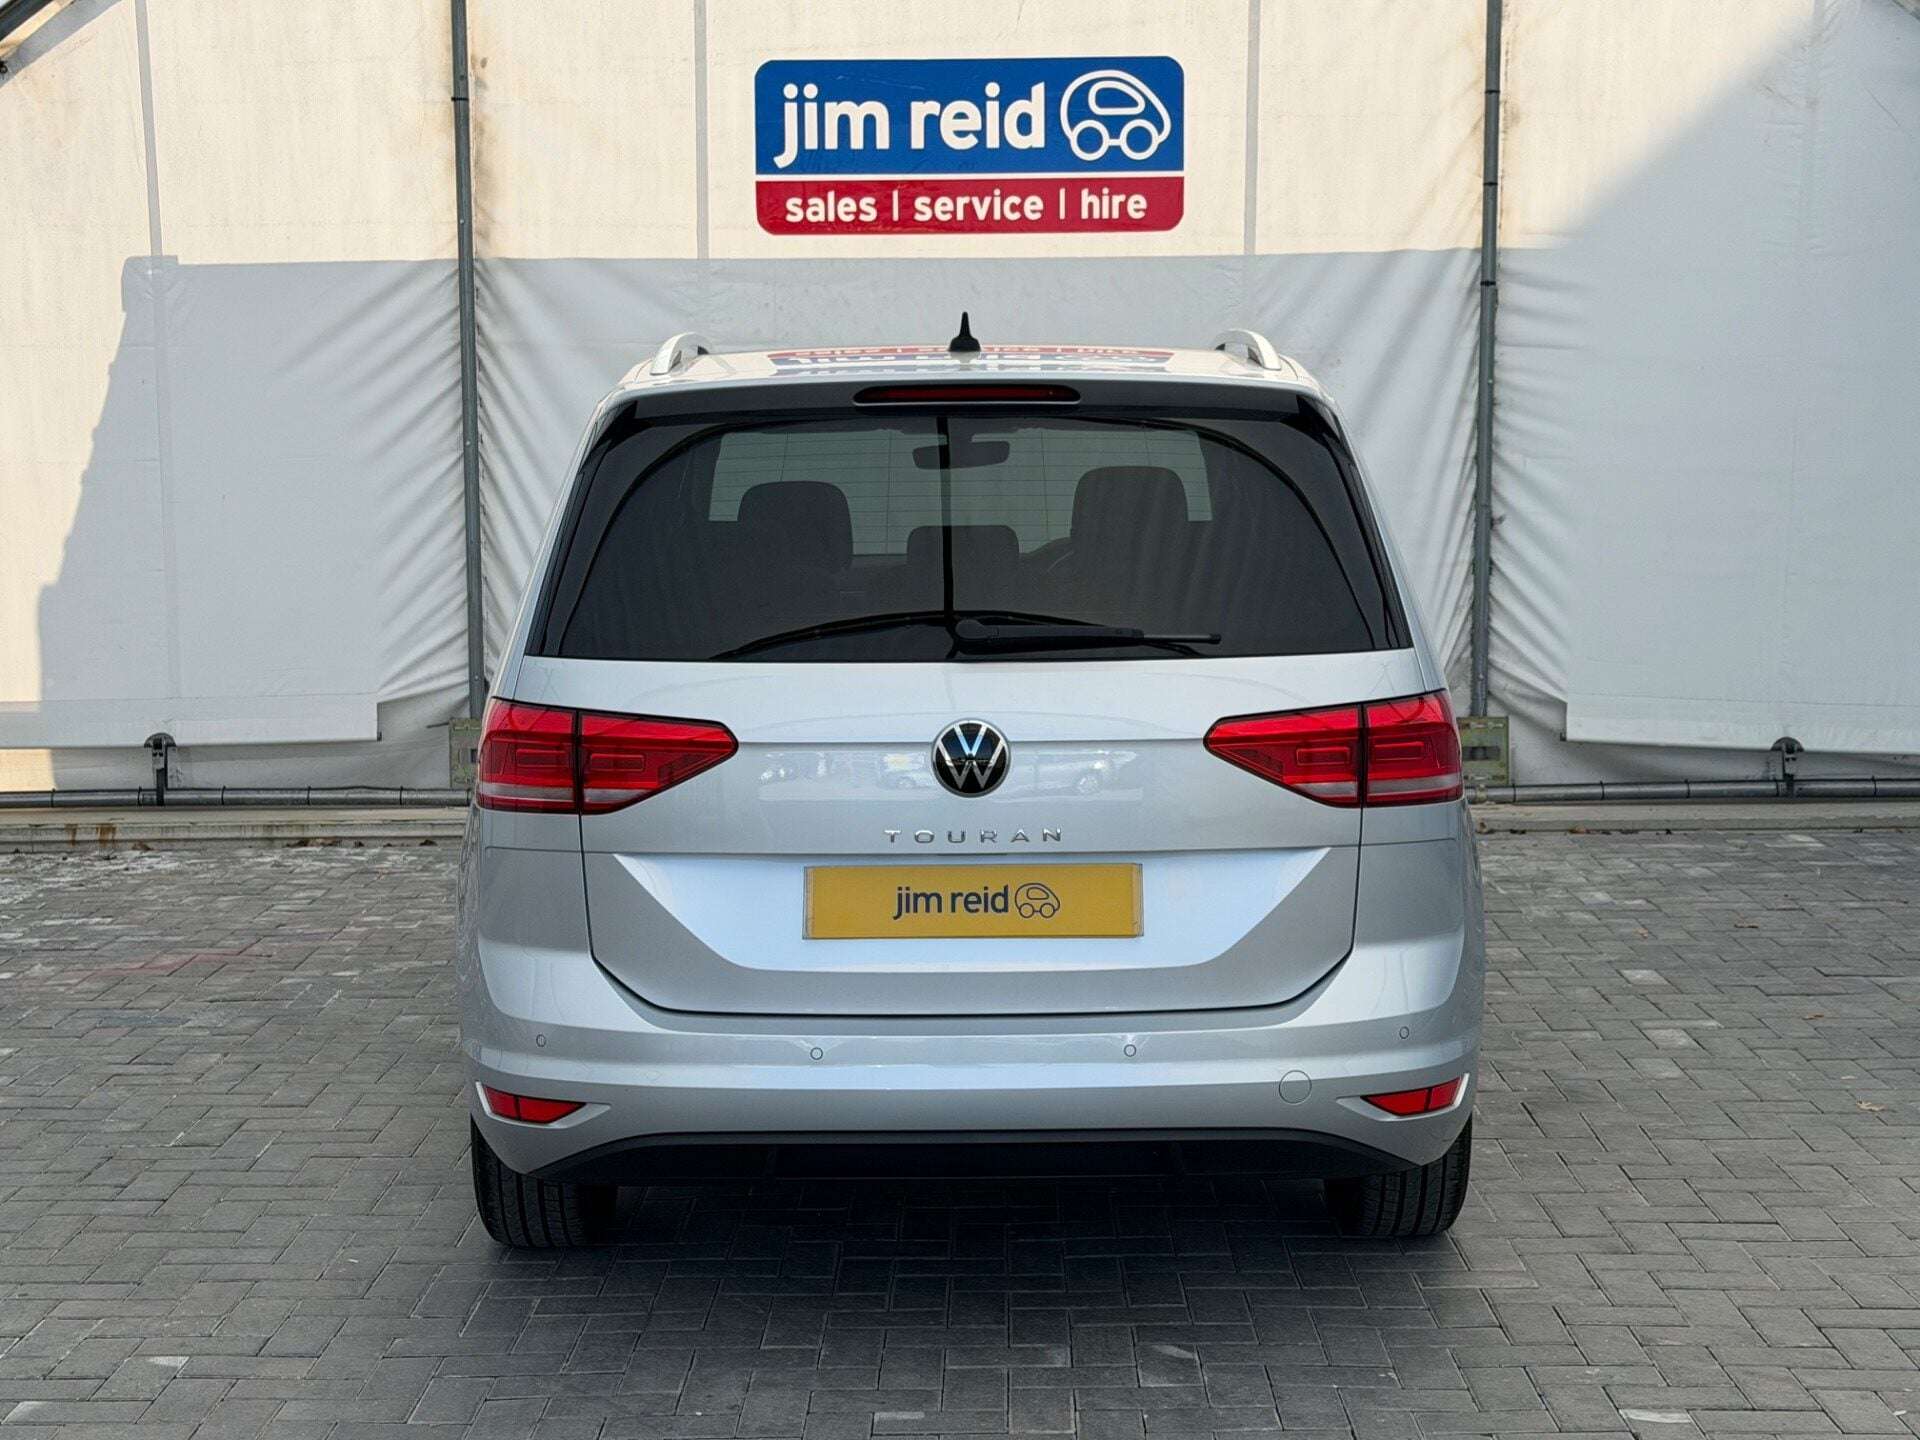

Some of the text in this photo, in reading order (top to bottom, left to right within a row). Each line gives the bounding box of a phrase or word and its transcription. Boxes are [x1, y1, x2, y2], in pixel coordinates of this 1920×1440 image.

[773, 81, 1045, 169] jim reid
[785, 190, 878, 223] sales
[913, 189, 1044, 222] service
[1080, 187, 1148, 220] hire
[884, 828, 1063, 844] TOURAN
[893, 885, 1009, 920] jim reid
